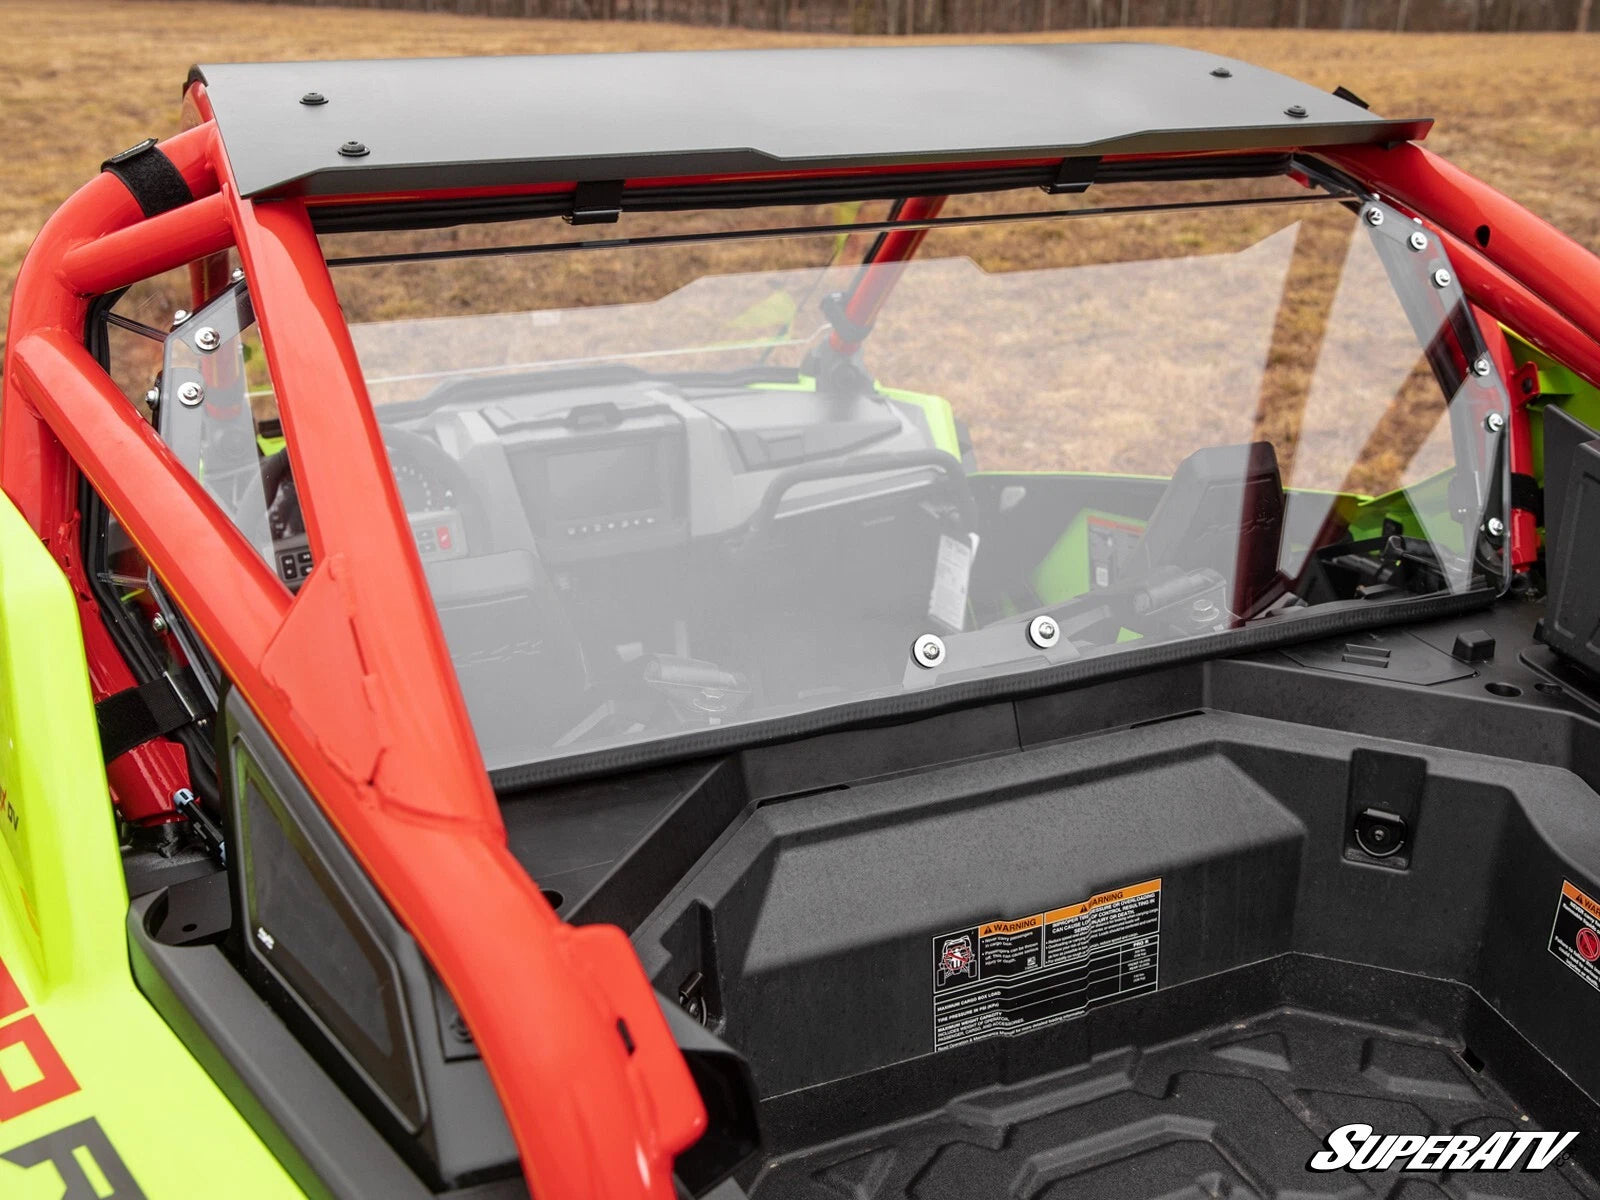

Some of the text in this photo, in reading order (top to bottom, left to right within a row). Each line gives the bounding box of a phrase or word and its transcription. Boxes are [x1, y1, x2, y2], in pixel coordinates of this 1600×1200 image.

[994, 918, 1036, 932] WARNING
[937, 1001, 960, 1011] MAXIMUM
[937, 1015, 948, 1023] TIRE
[948, 1009, 972, 1019] PRESSURE
[937, 1022, 960, 1032] MAXIMUM
[960, 1017, 978, 1026] WEIGHT
